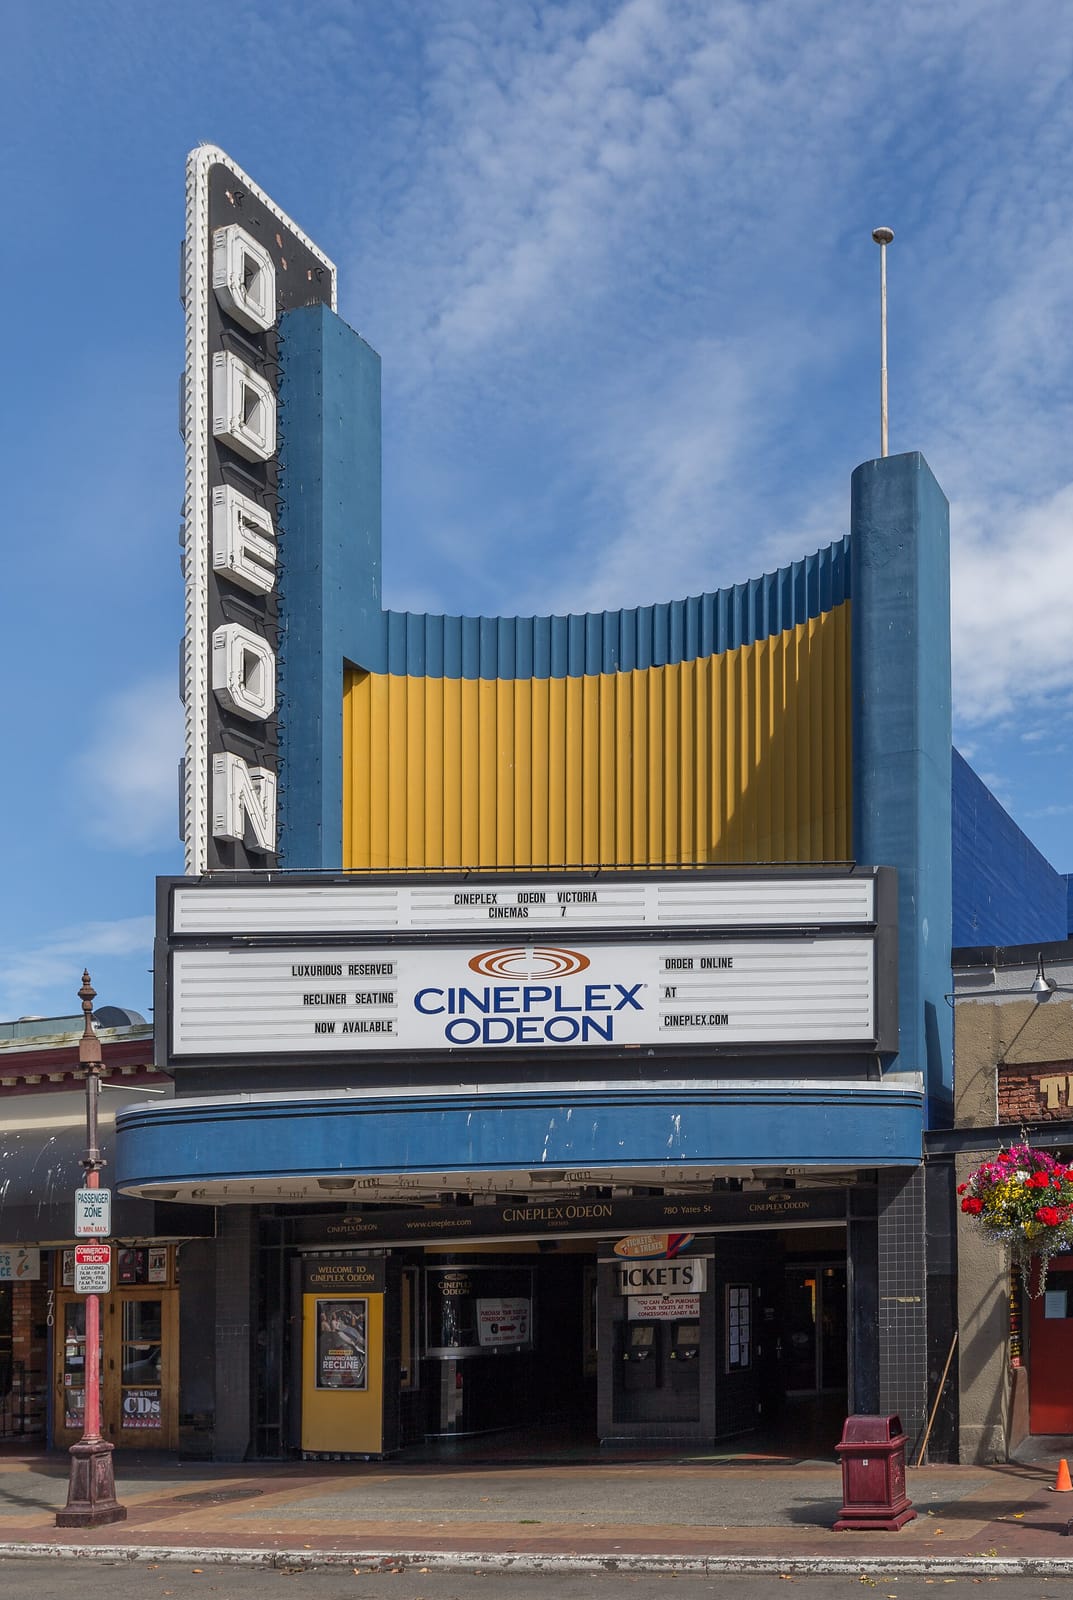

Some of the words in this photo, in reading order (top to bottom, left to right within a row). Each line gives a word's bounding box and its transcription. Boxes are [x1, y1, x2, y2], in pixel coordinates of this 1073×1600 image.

[211, 223, 277, 853] ODEON
[454, 893, 498, 905] CINEPLEX
[517, 892, 546, 904] ODEON
[557, 891, 598, 903] VICTORIA
[488, 907, 529, 919] CINEMAS
[560, 906, 567, 917] 7
[665, 958, 694, 969] ORDER
[700, 957, 733, 969] ONLINE
[291, 965, 343, 977] LUXURIOUS
[348, 964, 393, 976] RESERVED
[303, 993, 347, 1005] RECLINER
[355, 992, 394, 1004] SEATING
[665, 986, 677, 998] AT
[413, 983, 644, 1015] CINEPLEX
[664, 1014, 729, 1027] CINEPLEX.COM
[314, 1022, 336, 1034] NOW
[342, 1021, 393, 1033] AVAILABLE
[444, 1015, 613, 1045] ODEON
[1040, 1075, 1073, 1109] T
[78, 1193, 109, 1203] PASSENGER
[84, 1206, 102, 1217] ZONE
[502, 1207, 563, 1222] CINEPLEX
[566, 1204, 613, 1219] ODEON
[663, 1206, 678, 1214] 780
[681, 1206, 701, 1214] Yates
[749, 1203, 783, 1212] CINEPLEX
[406, 1219, 472, 1229] www.cineplex.com
[640, 1242, 664, 1253] TREATS
[356, 1265, 367, 1273] TO
[310, 1273, 345, 1282] CINEPLEX
[347, 1273, 375, 1282] ODEON
[322, 1360, 359, 1369] RECLINE
[123, 1397, 160, 1413] CDs
